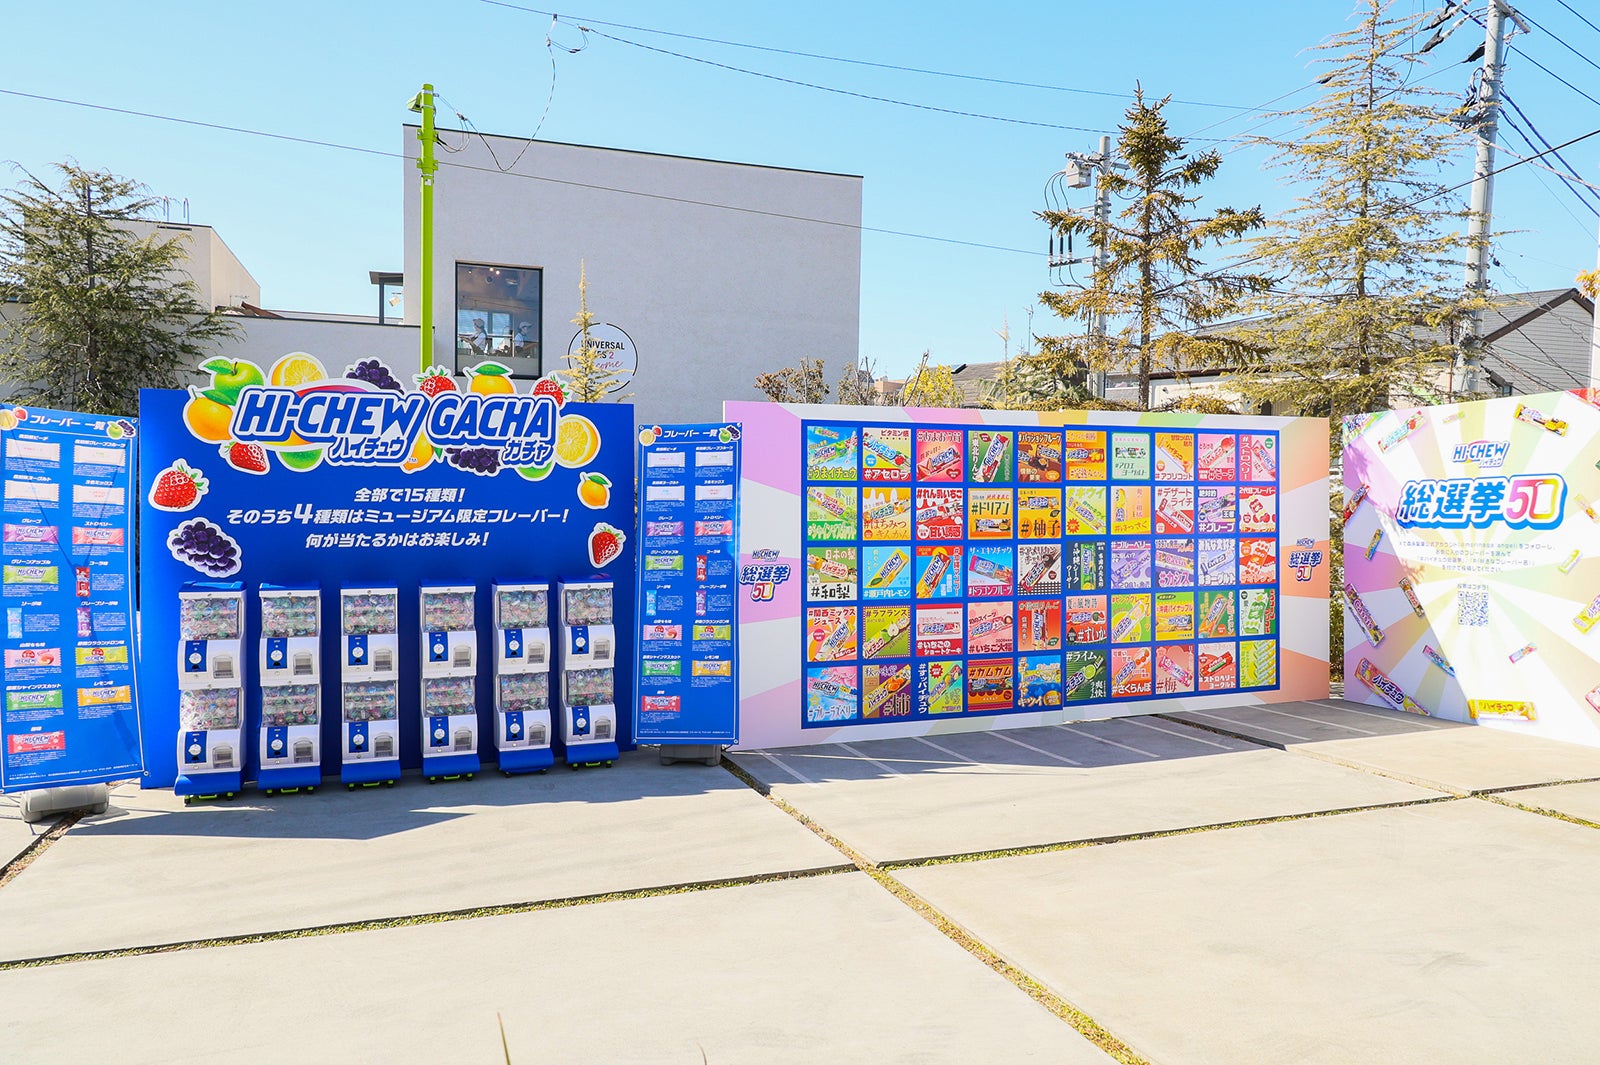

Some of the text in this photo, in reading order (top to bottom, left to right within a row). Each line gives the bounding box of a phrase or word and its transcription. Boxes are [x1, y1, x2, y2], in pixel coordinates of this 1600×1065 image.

[581, 340, 624, 350] NIVERSAL
[30, 414, 82, 427] フレーバー
[240, 395, 555, 438] HI-CHEW GACHA
[330, 436, 552, 462] ハイチュウ ガチャ
[1453, 442, 1509, 460] HI-CHEW
[1241, 436, 1250, 479] #ストロベリー
[808, 466, 856, 479] #うまイチュウ
[864, 469, 909, 479] #アセロラ
[354, 487, 466, 502] 全部で15種類!
[1398, 478, 1559, 521] 総選挙50
[971, 502, 1010, 515] #ドリアン
[1170, 498, 1192, 506] ライチ
[226, 503, 570, 525] そのうち4種類はミュージアム限定フレーバー!
[1021, 520, 1060, 536] #柚子
[1199, 523, 1234, 532] #グレープ
[304, 533, 488, 548] 何が当たるかはお楽しみ!
[825, 549, 856, 560] 日本の梨
[741, 566, 788, 581] 総選挙
[1297, 566, 1310, 578] 50
[753, 582, 774, 598] 50
[811, 584, 850, 599] #和梨
[808, 609, 856, 617] #関西ミックス
[814, 617, 841, 626] ジュース
[924, 646, 961, 654] ショートケーキ
[969, 643, 1012, 653] #いちご大福
[1066, 651, 1097, 661] #ライム
[970, 667, 1012, 678] #カムカム
[1112, 682, 1151, 694] #さくらんぼ
[1157, 677, 1177, 692] #梅
[1373, 675, 1404, 704] ハイチュウ
[884, 694, 910, 715] #柿
